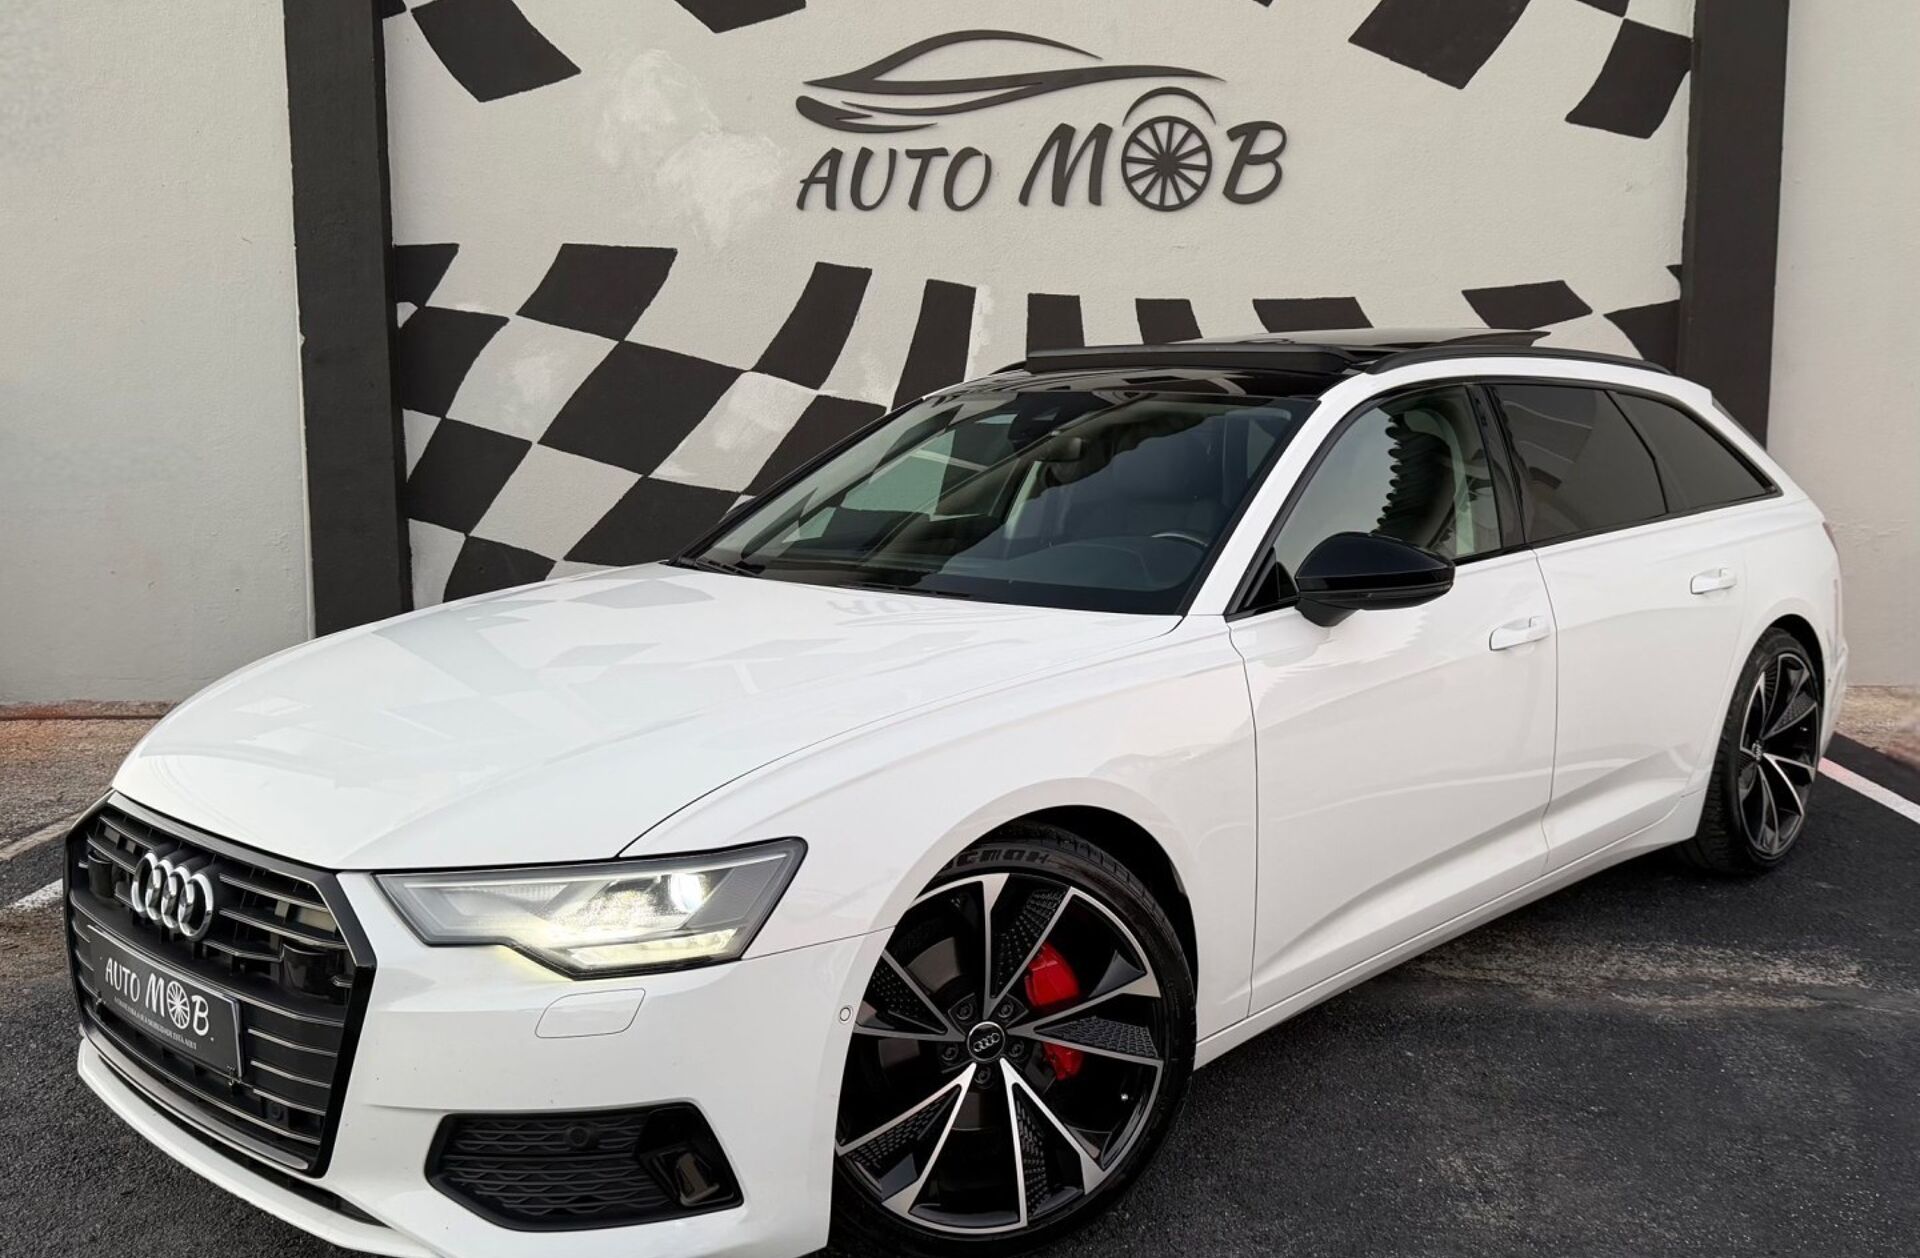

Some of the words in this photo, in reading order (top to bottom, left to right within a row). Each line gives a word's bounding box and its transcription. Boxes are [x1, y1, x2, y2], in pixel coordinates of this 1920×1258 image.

[796, 146, 992, 212] AUTO
[1018, 115, 1288, 212] MOB
[104, 957, 141, 1002] AUTO
[144, 972, 210, 1037] MOB
